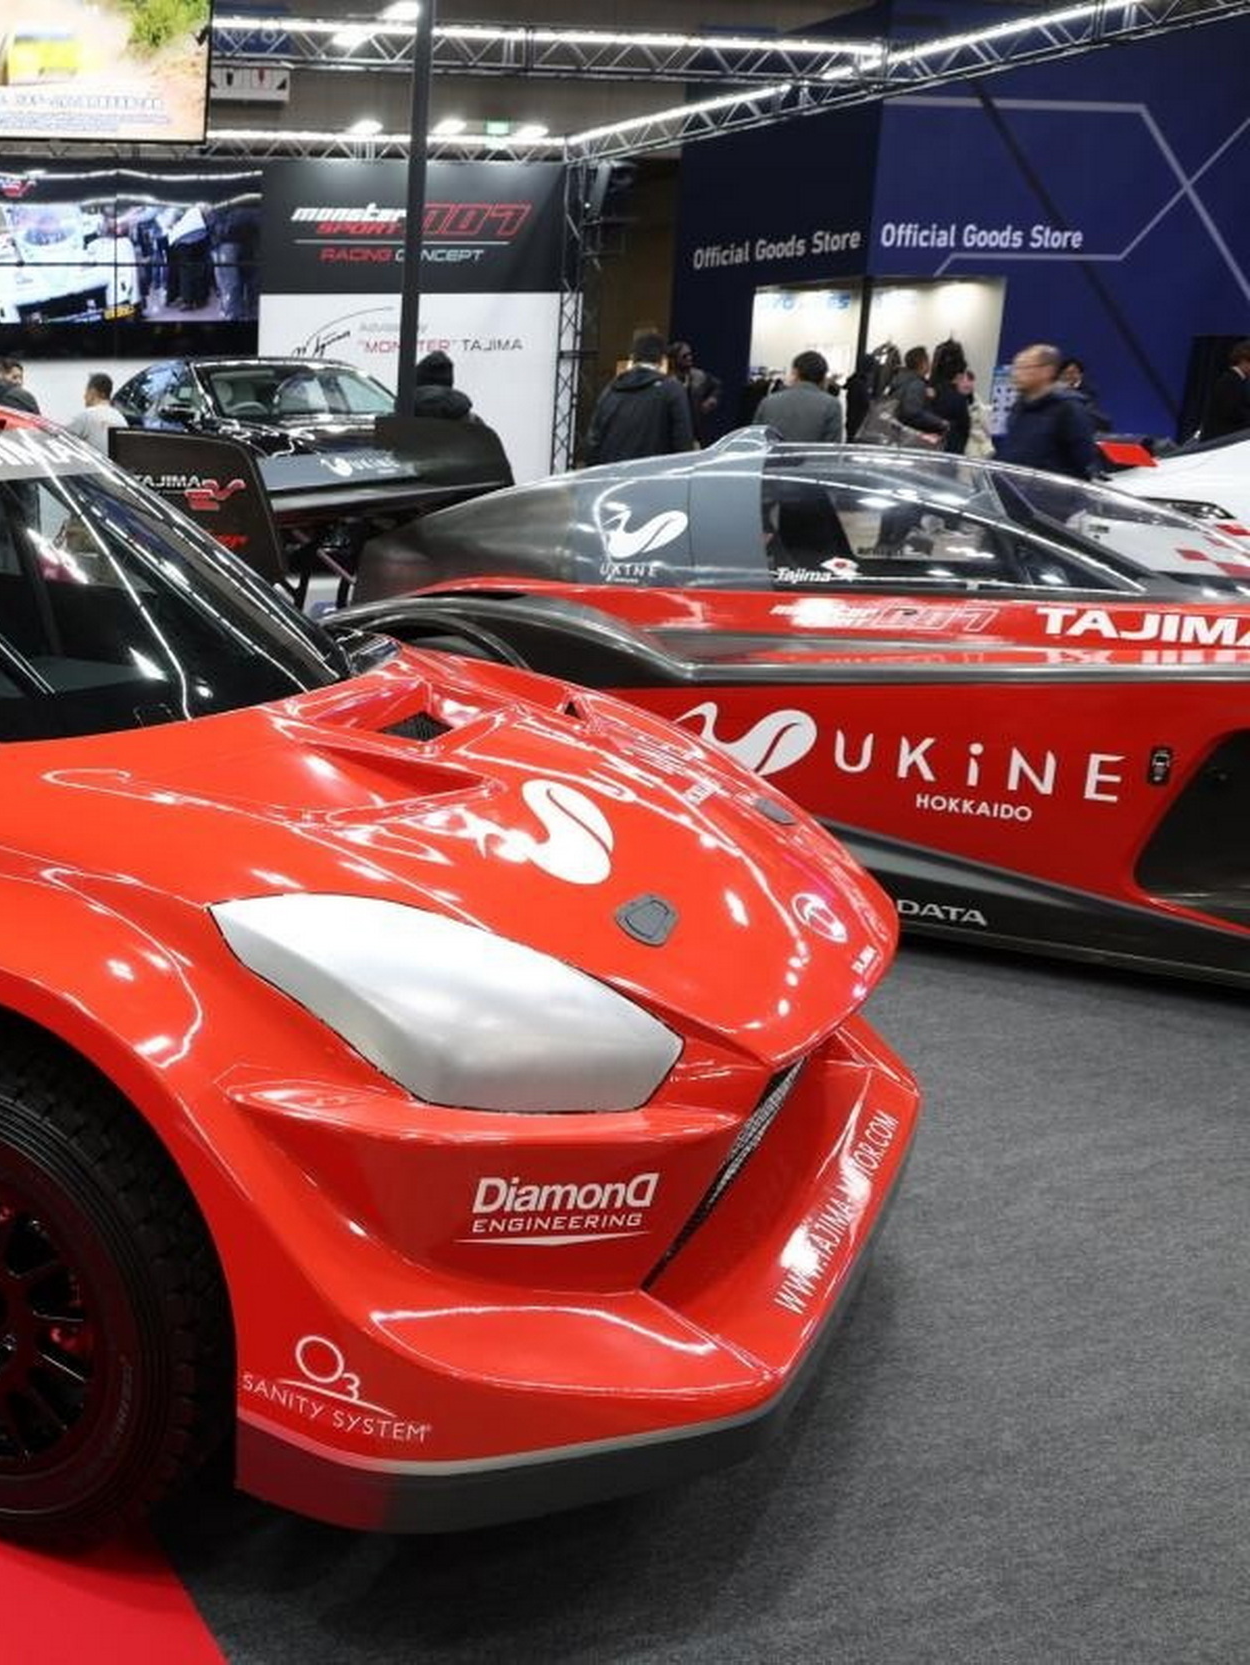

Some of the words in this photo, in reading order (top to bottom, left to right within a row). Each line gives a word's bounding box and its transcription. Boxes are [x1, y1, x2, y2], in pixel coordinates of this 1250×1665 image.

[880, 222, 956, 249] Official
[962, 223, 1024, 249] Goods
[1029, 225, 1084, 249] Store
[319, 249, 392, 263] RACING
[394, 249, 485, 263] CNCEPT
[692, 240, 750, 270] Official
[754, 235, 807, 262] Goods
[810, 230, 862, 254] Store
[461, 338, 523, 352] TAJIMA
[775, 567, 832, 585] Tajima
[915, 793, 1034, 823] HOKKAIDO
[472, 1213, 643, 1233] ENGINEERING
[242, 1373, 324, 1420] SANITY
